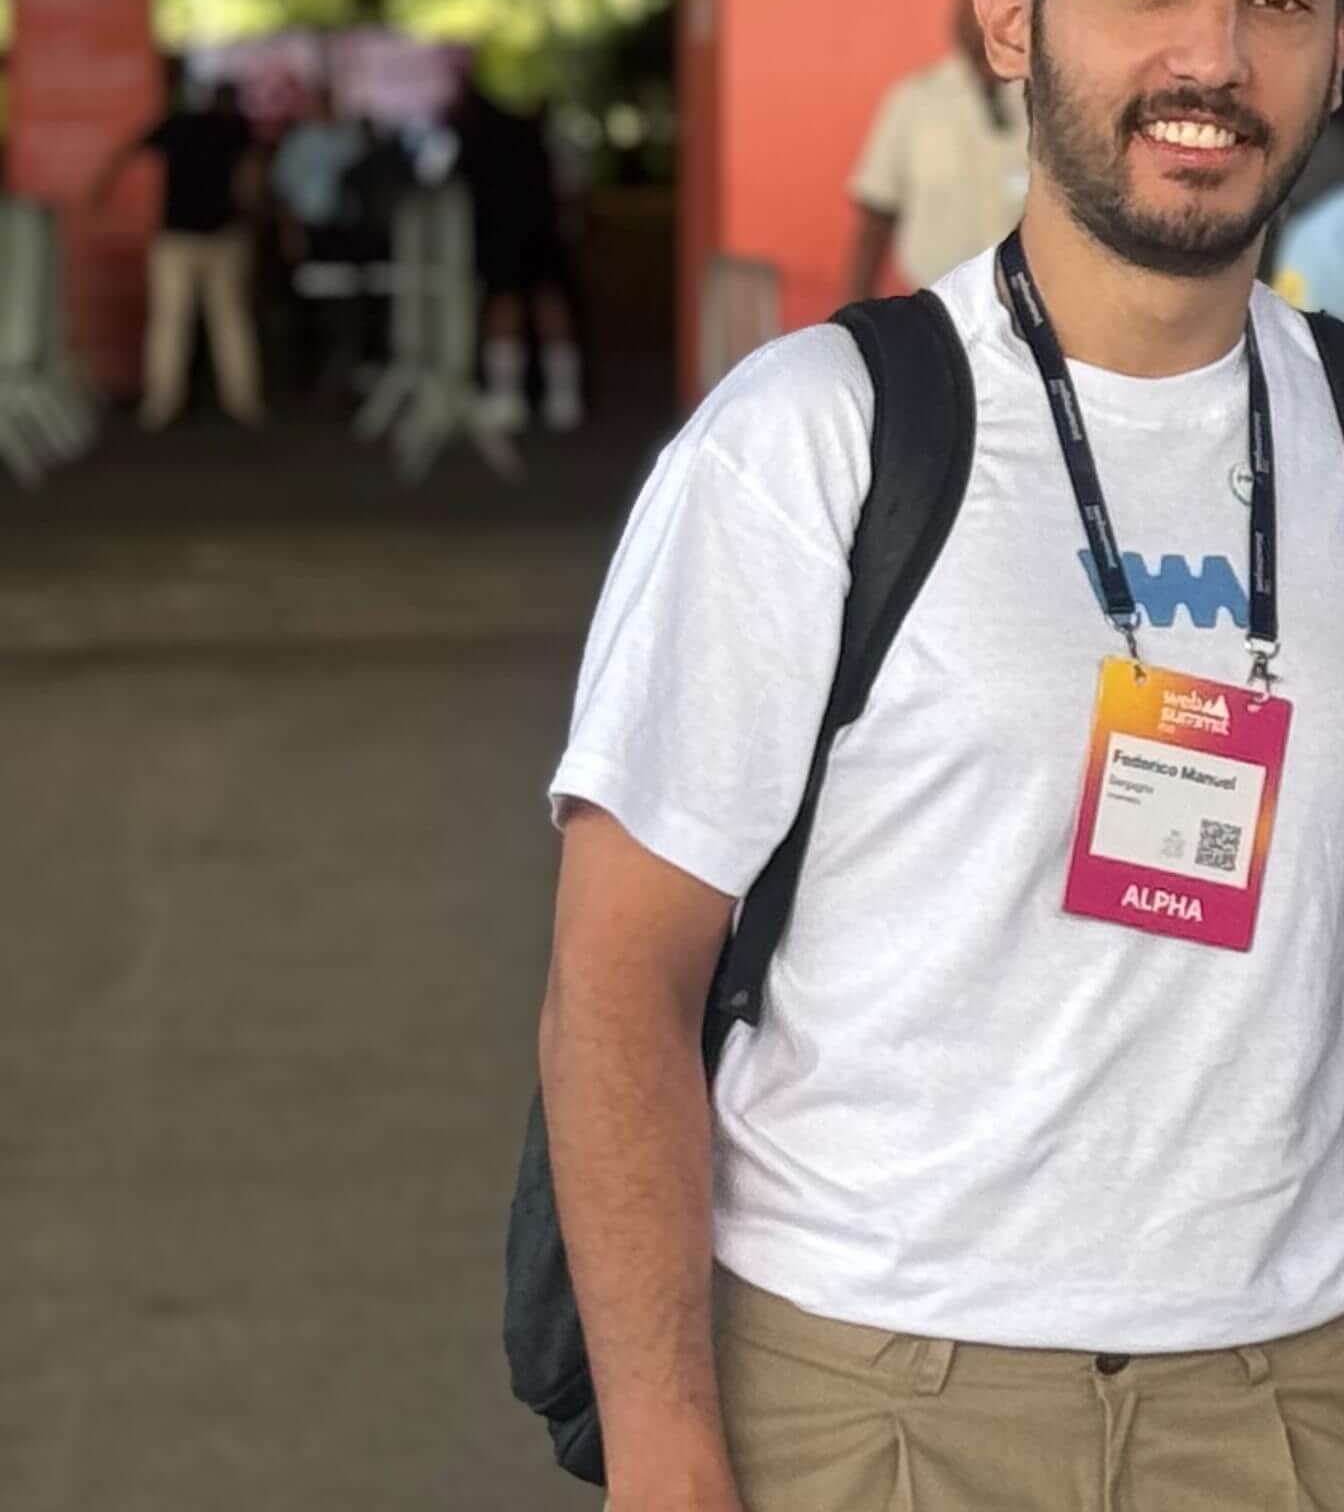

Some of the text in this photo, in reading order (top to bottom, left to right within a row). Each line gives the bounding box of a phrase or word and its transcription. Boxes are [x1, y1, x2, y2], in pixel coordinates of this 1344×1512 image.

[1163, 691, 1202, 715] web
[1113, 749, 1178, 778] Federico
[1181, 765, 1237, 791] Manuel
[1121, 885, 1203, 921] ALPHA
